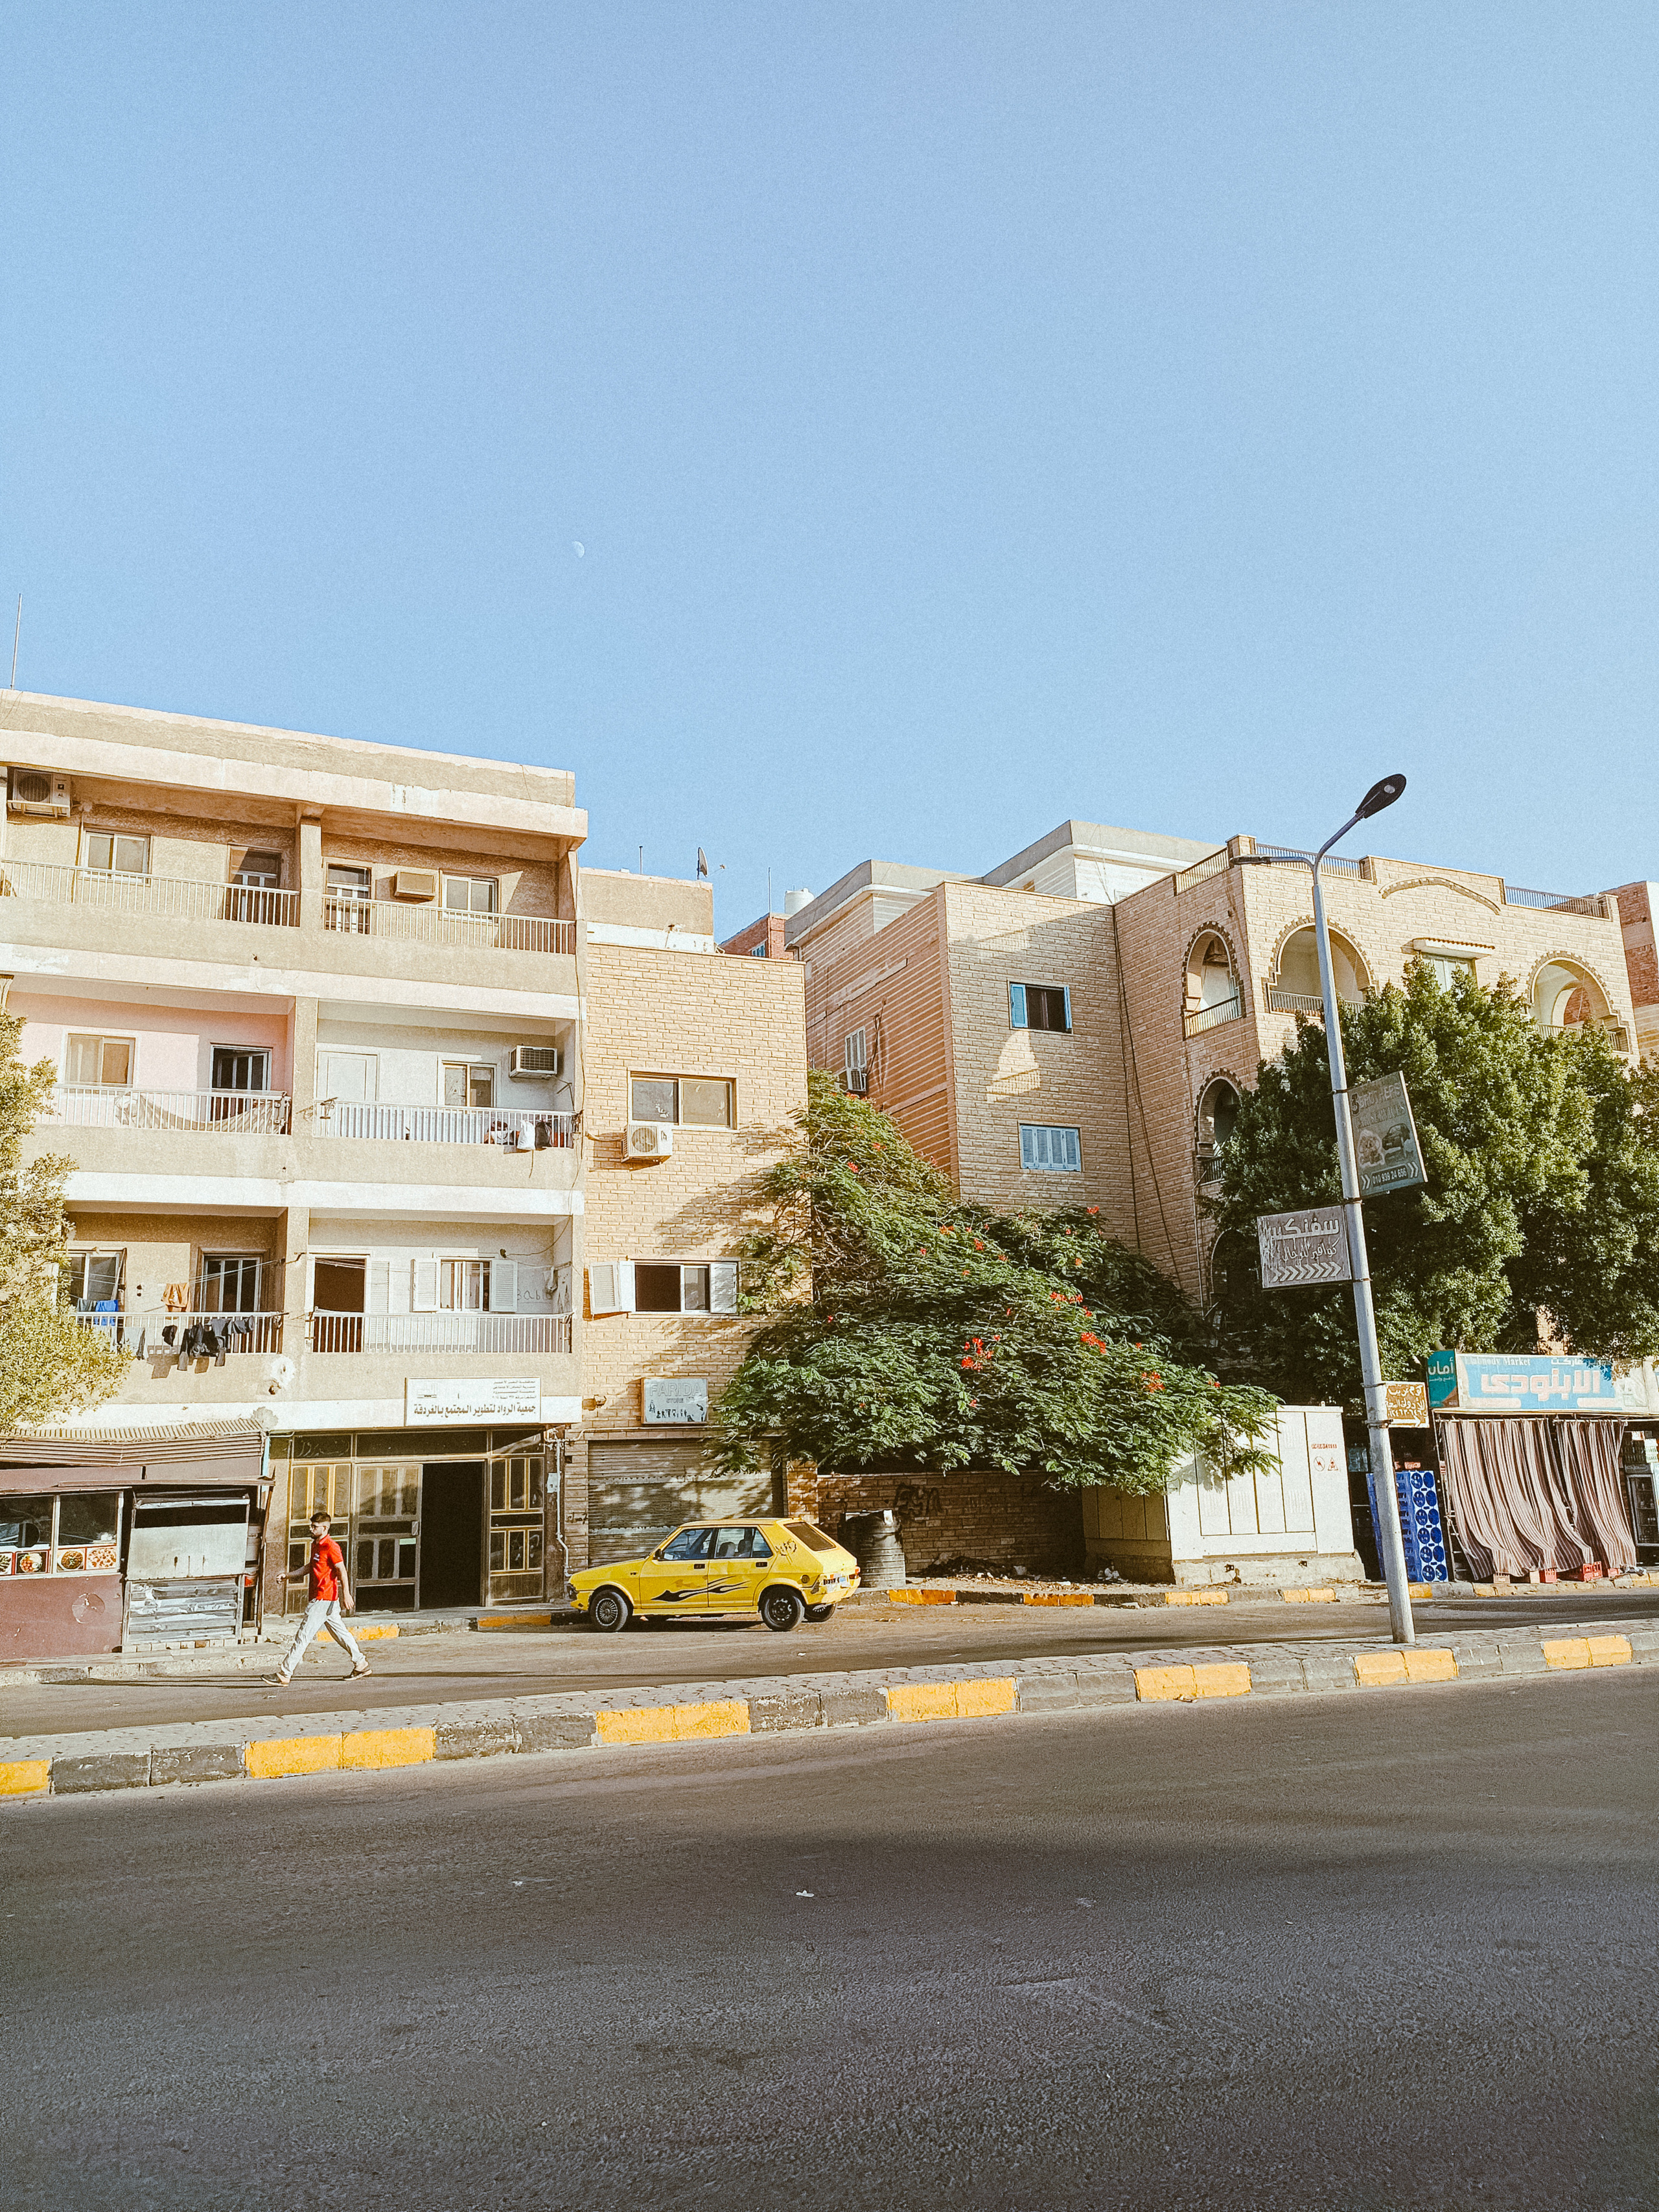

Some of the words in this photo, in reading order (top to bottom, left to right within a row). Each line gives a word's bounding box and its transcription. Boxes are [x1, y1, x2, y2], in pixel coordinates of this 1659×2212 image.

[1372, 1174, 1382, 1185] 010
[1381, 1172, 1391, 1182] 939
[1391, 1170, 1398, 1180] 24
[1311, 1237, 1340, 1259] كوافير
[1503, 1357, 1531, 1366] Market
[649, 1382, 702, 1397] FARIDA
[413, 1404, 444, 1418] بالغردقة
[445, 1404, 472, 1419] المجتمع
[472, 1404, 496, 1417] لتطوير
[497, 1403, 516, 1416] الرواد
[516, 1402, 536, 1416] جمعية
